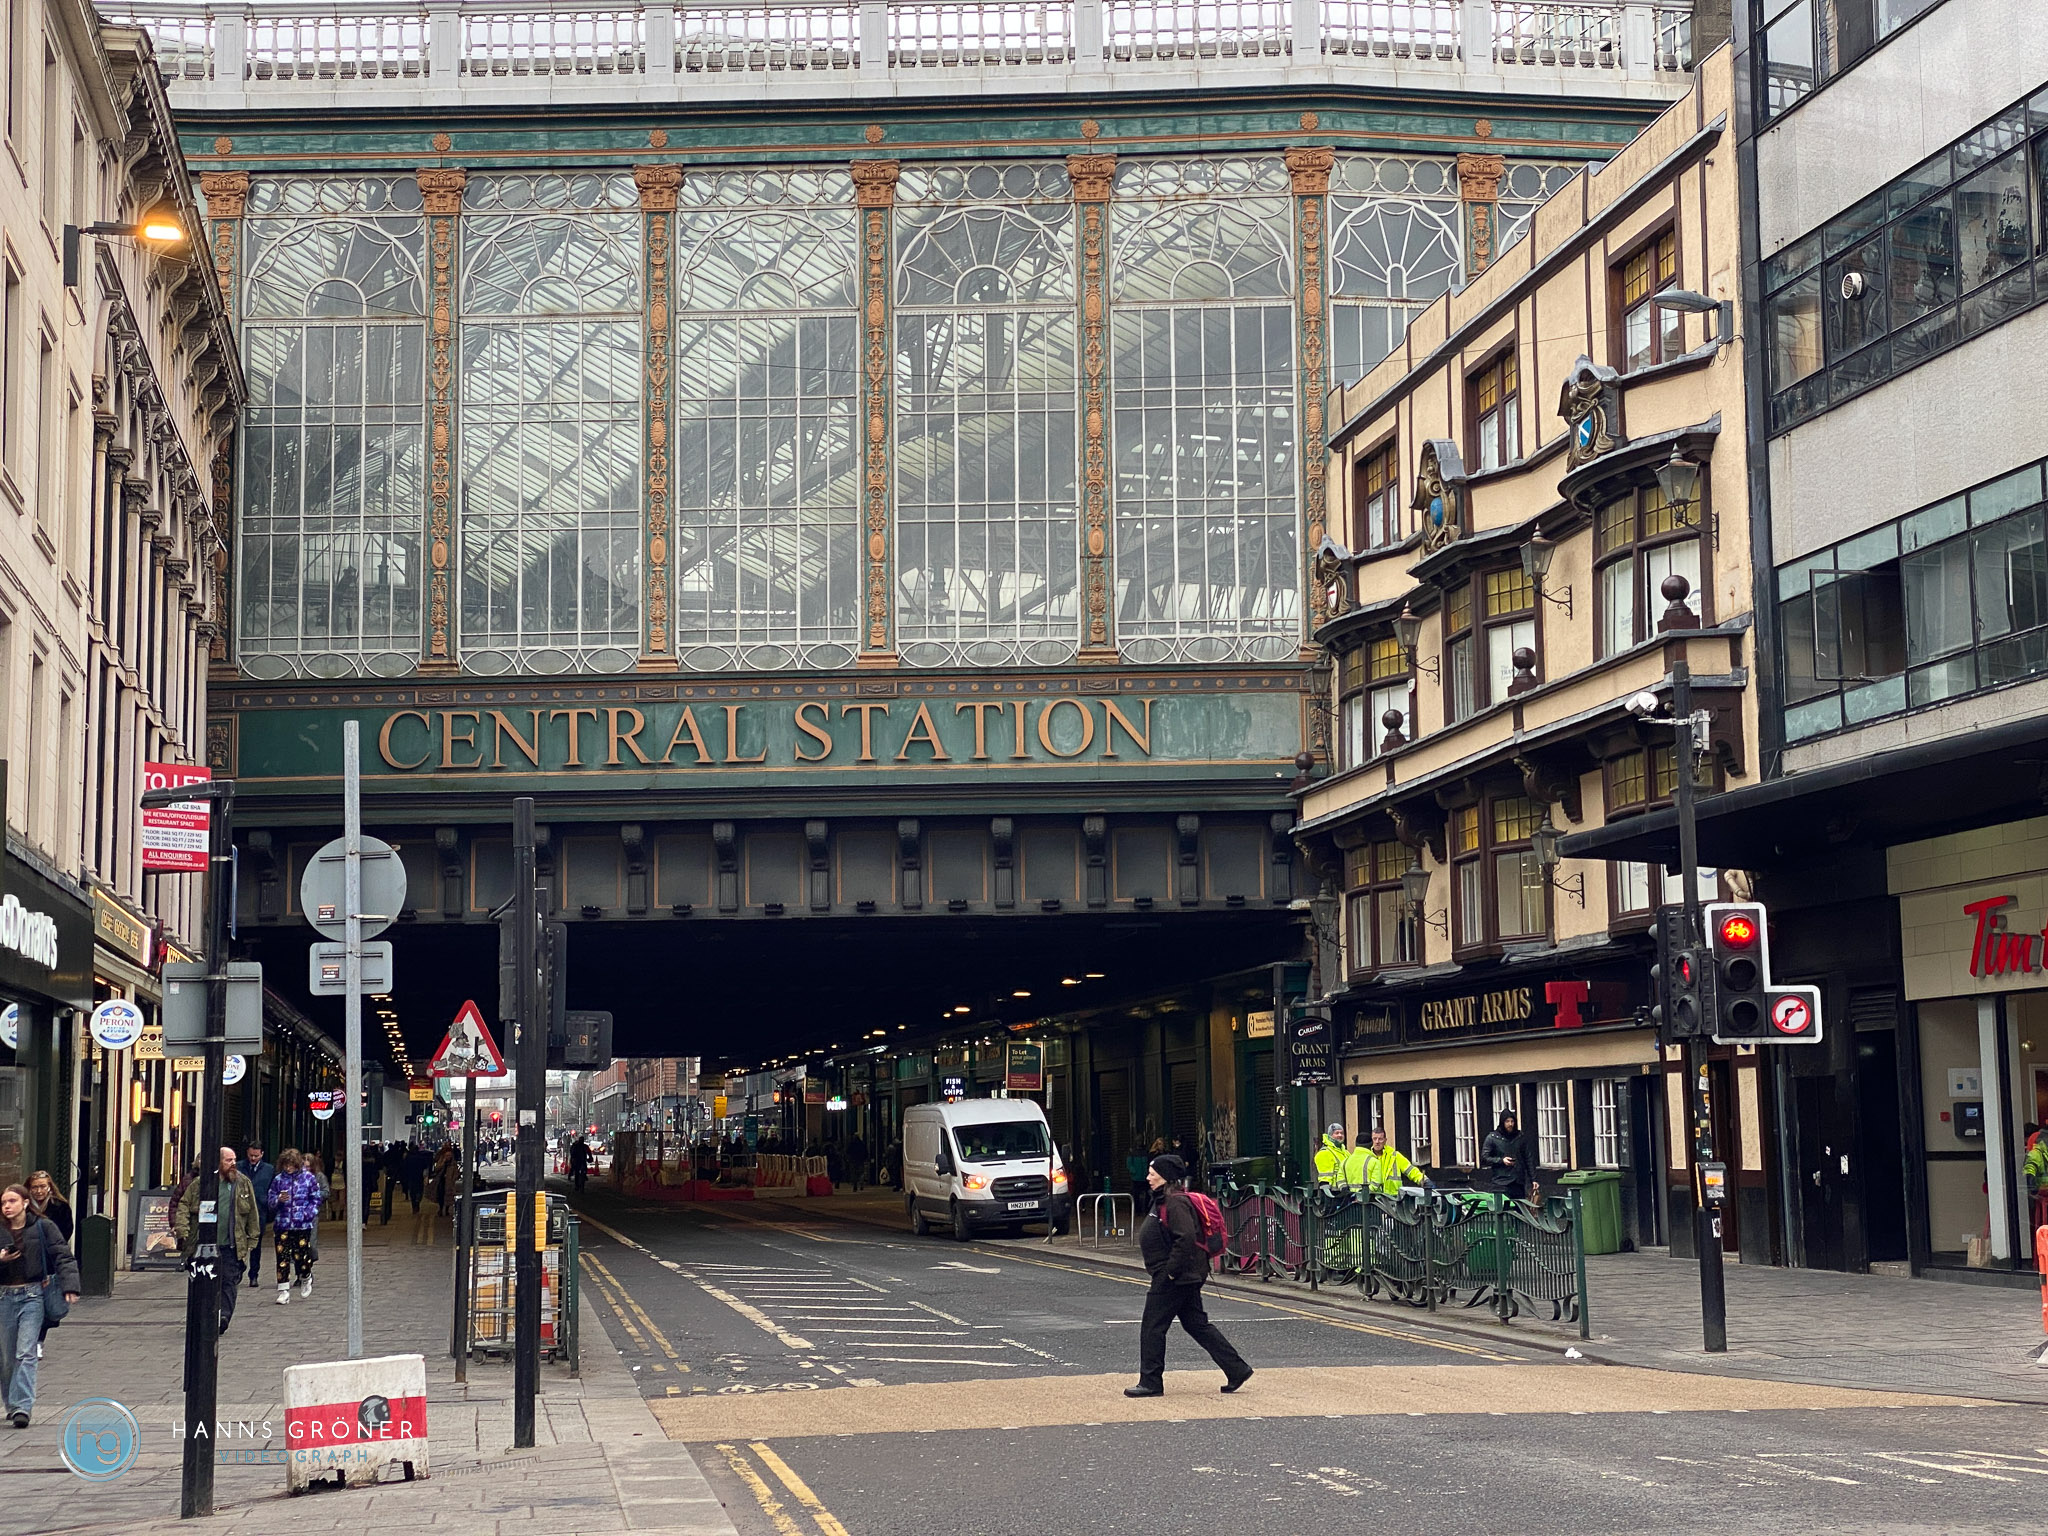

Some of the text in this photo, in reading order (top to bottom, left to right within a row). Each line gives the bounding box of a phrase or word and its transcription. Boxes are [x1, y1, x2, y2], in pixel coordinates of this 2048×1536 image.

[379, 698, 1158, 769] CENTRAL STATION
[144, 772, 166, 790] TO
[152, 812, 207, 821] RETAIL/OFFICE/LEISURE
[160, 852, 193, 860] ENQUIRIES:
[1963, 895, 2033, 978] Tim
[1421, 996, 1475, 1031] GRANT
[1480, 988, 1531, 1023] ARMS
[100, 1018, 134, 1026] PERONI
[1297, 1024, 1323, 1036] CARLING
[1292, 1042, 1330, 1055] GRANT
[1300, 1058, 1326, 1068] ARMS
